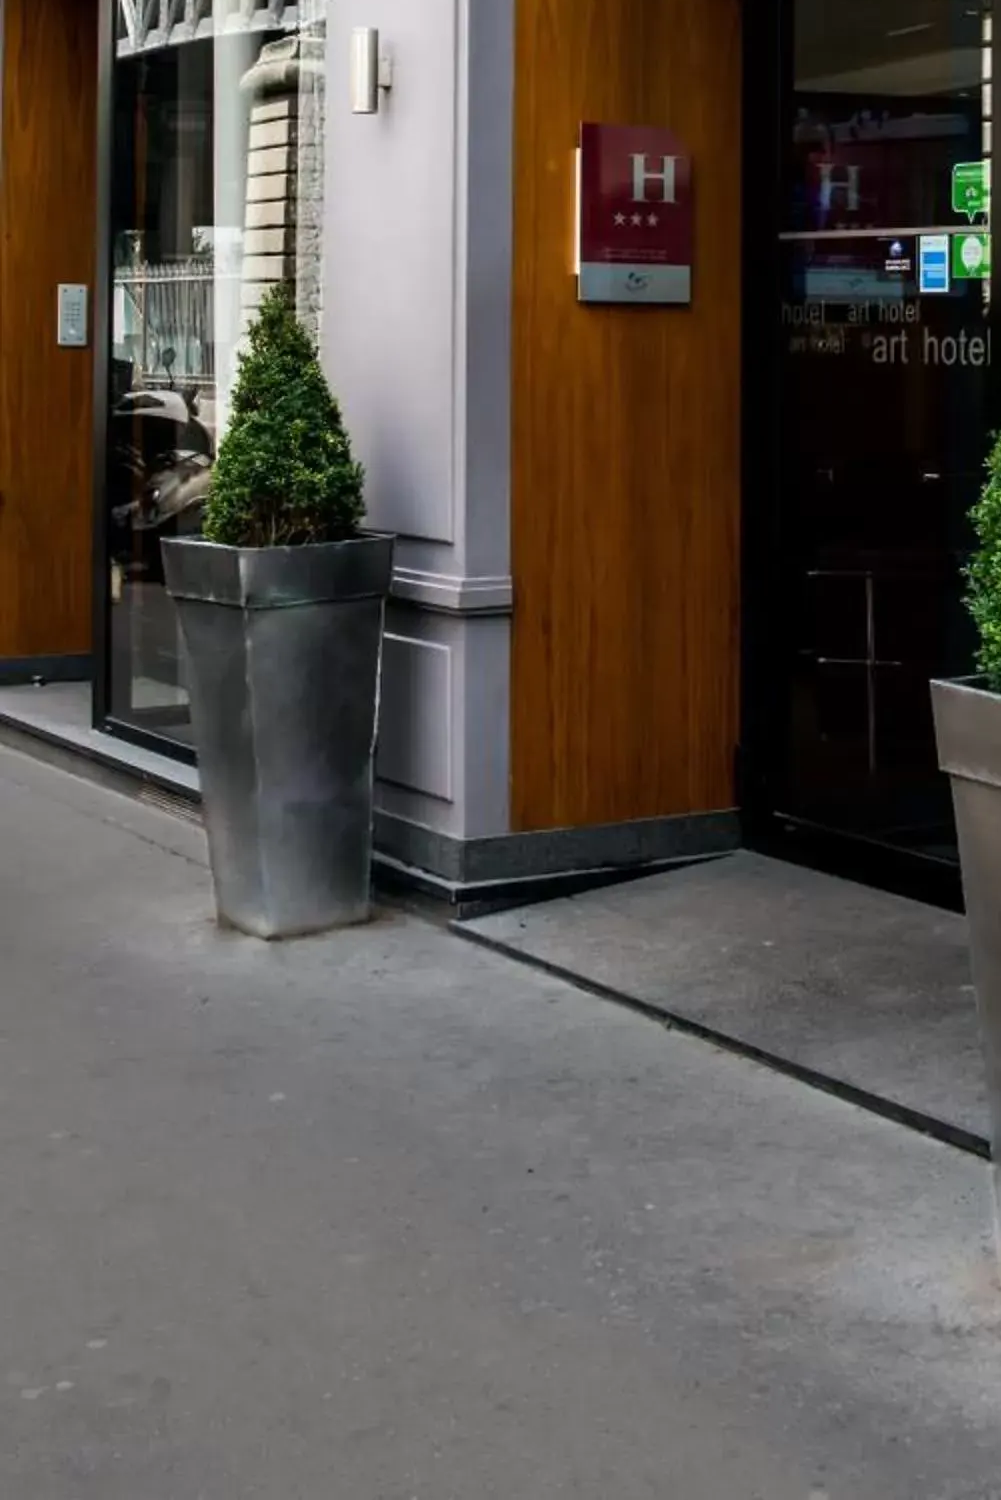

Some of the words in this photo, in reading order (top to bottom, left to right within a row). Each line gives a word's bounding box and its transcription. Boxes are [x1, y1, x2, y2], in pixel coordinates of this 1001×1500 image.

[629, 152, 685, 204] H
[780, 299, 826, 326] hotel
[877, 297, 921, 324] hotel
[871, 328, 909, 365] art
[922, 325, 992, 367] hotel
